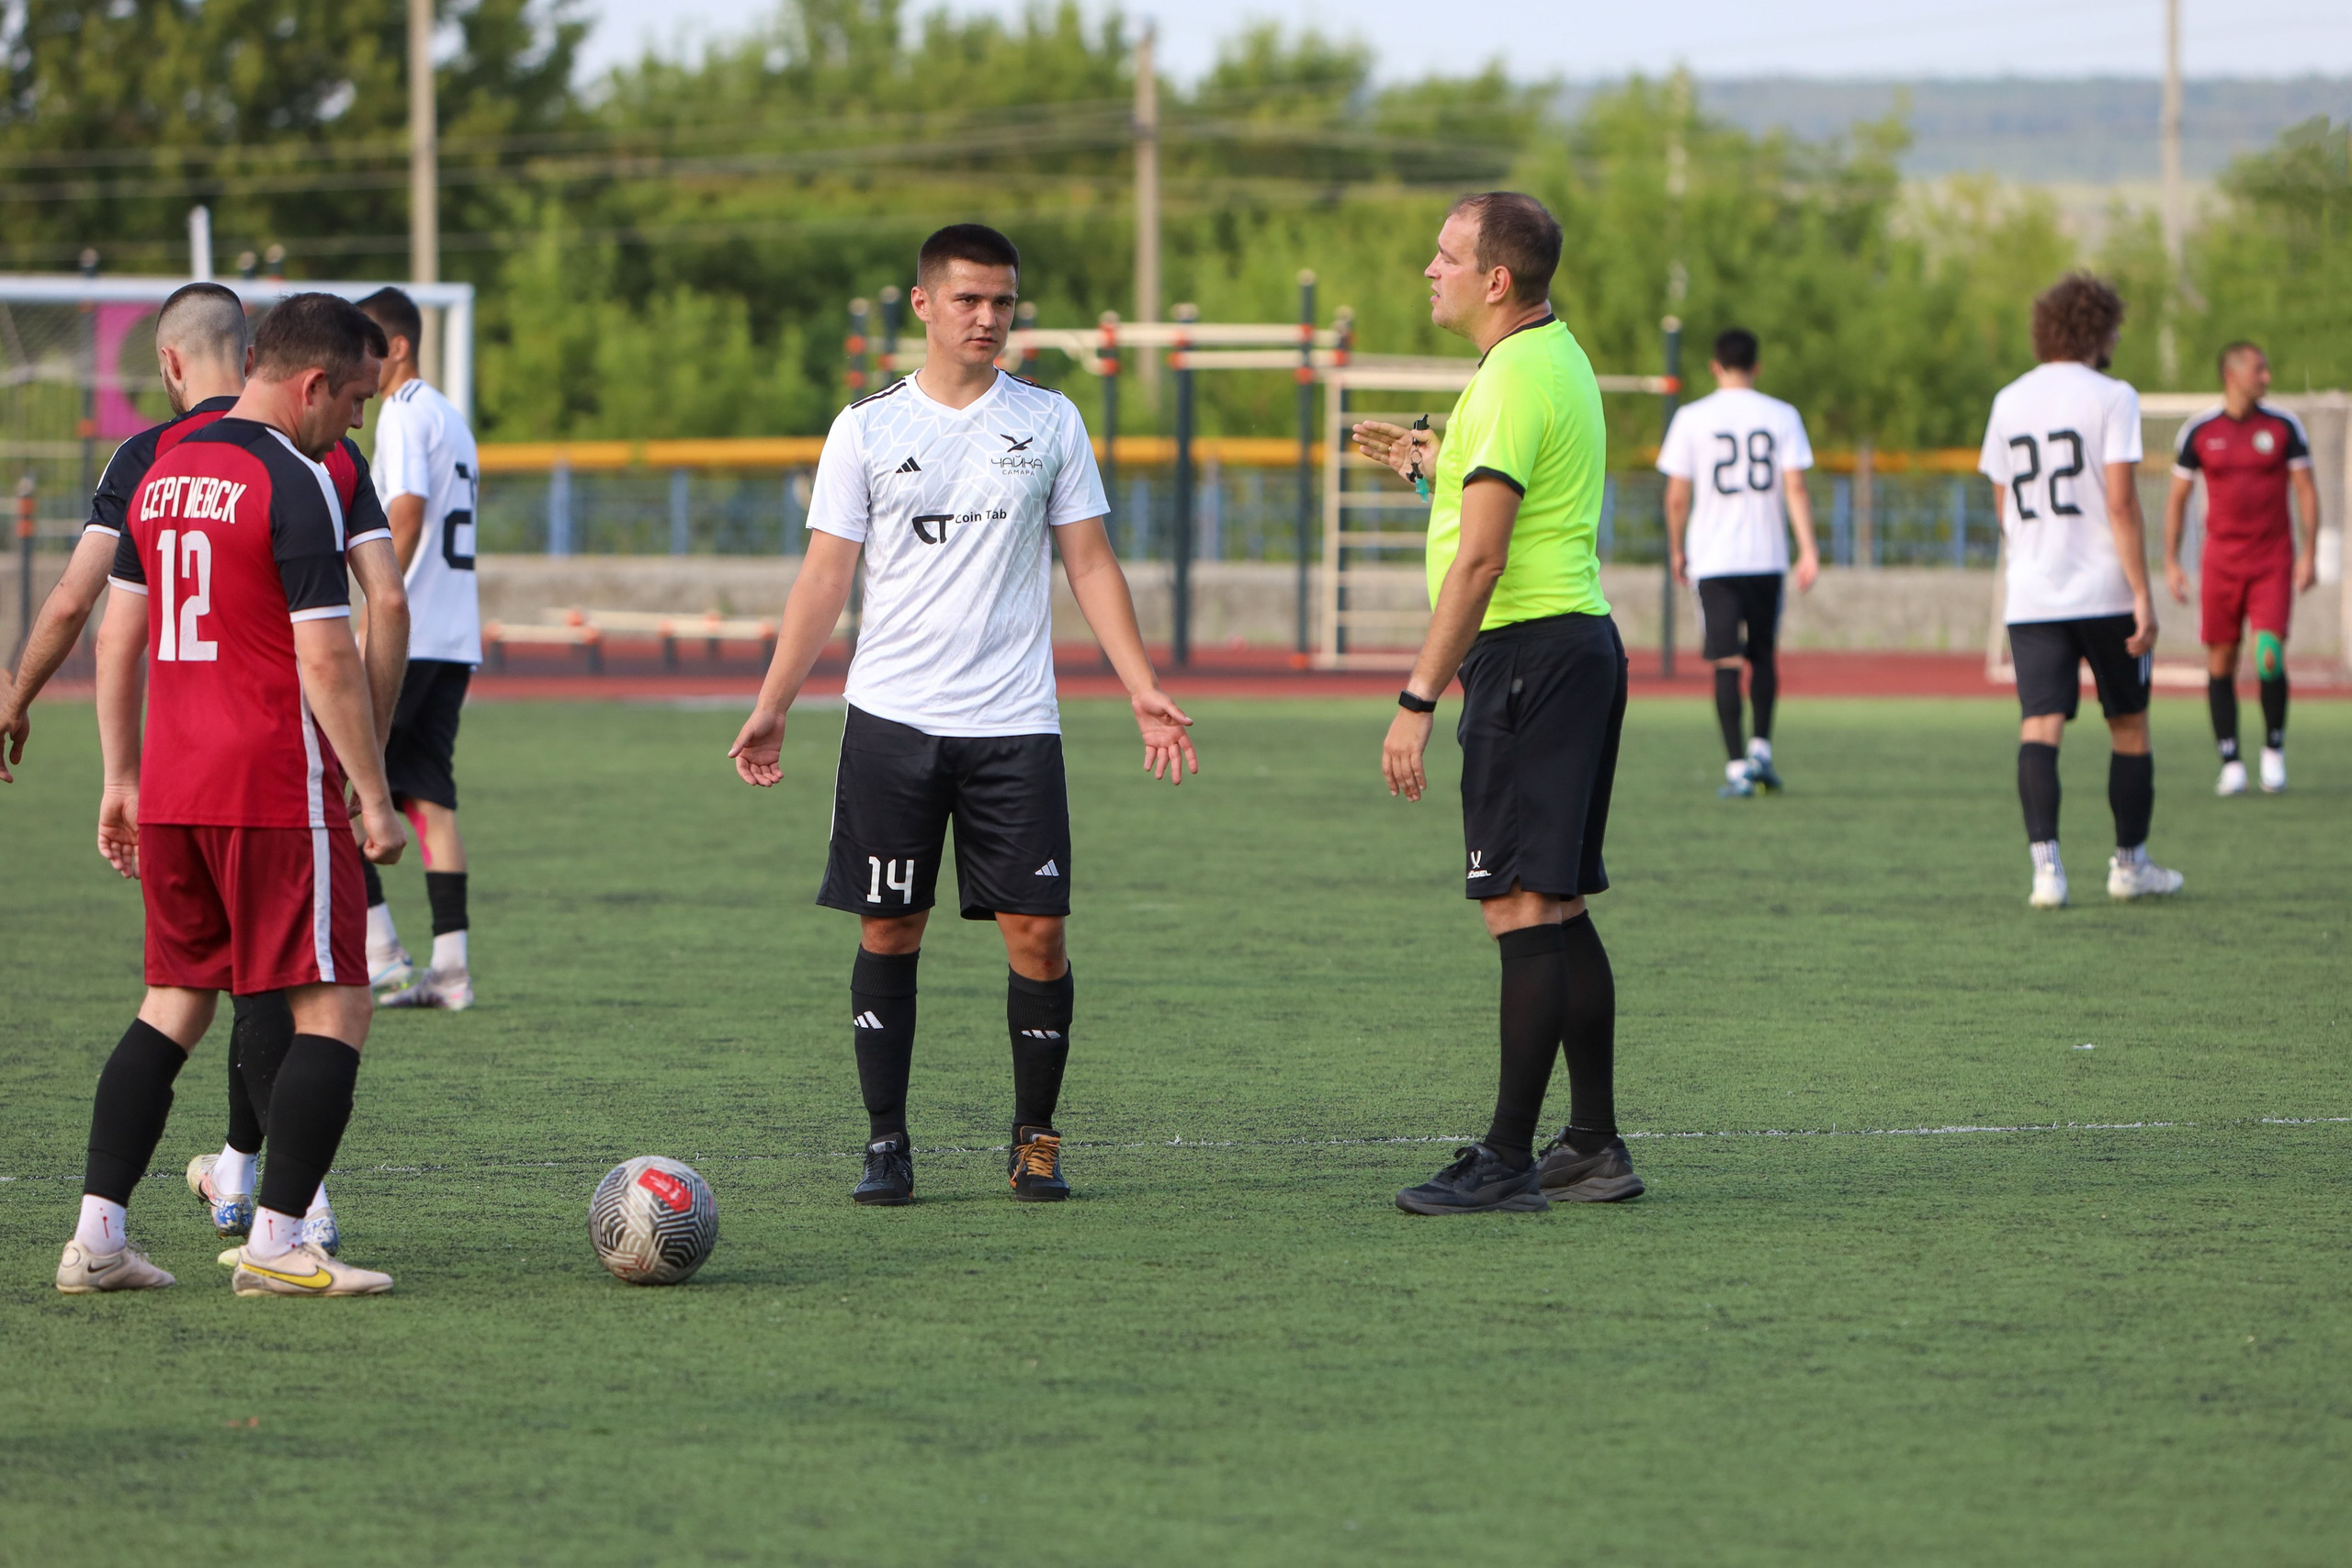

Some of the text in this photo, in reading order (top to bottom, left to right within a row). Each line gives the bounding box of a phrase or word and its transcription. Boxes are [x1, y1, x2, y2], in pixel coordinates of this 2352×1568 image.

[990, 455, 1043, 469] ЧАЙКА
[1713, 430, 1774, 495] 28
[2008, 430, 2085, 521] 22
[141, 476, 247, 524] СЕРГИЕВСК
[956, 508, 1007, 524] Coin Tab
[156, 529, 218, 661] 12
[866, 855, 915, 905] 14
